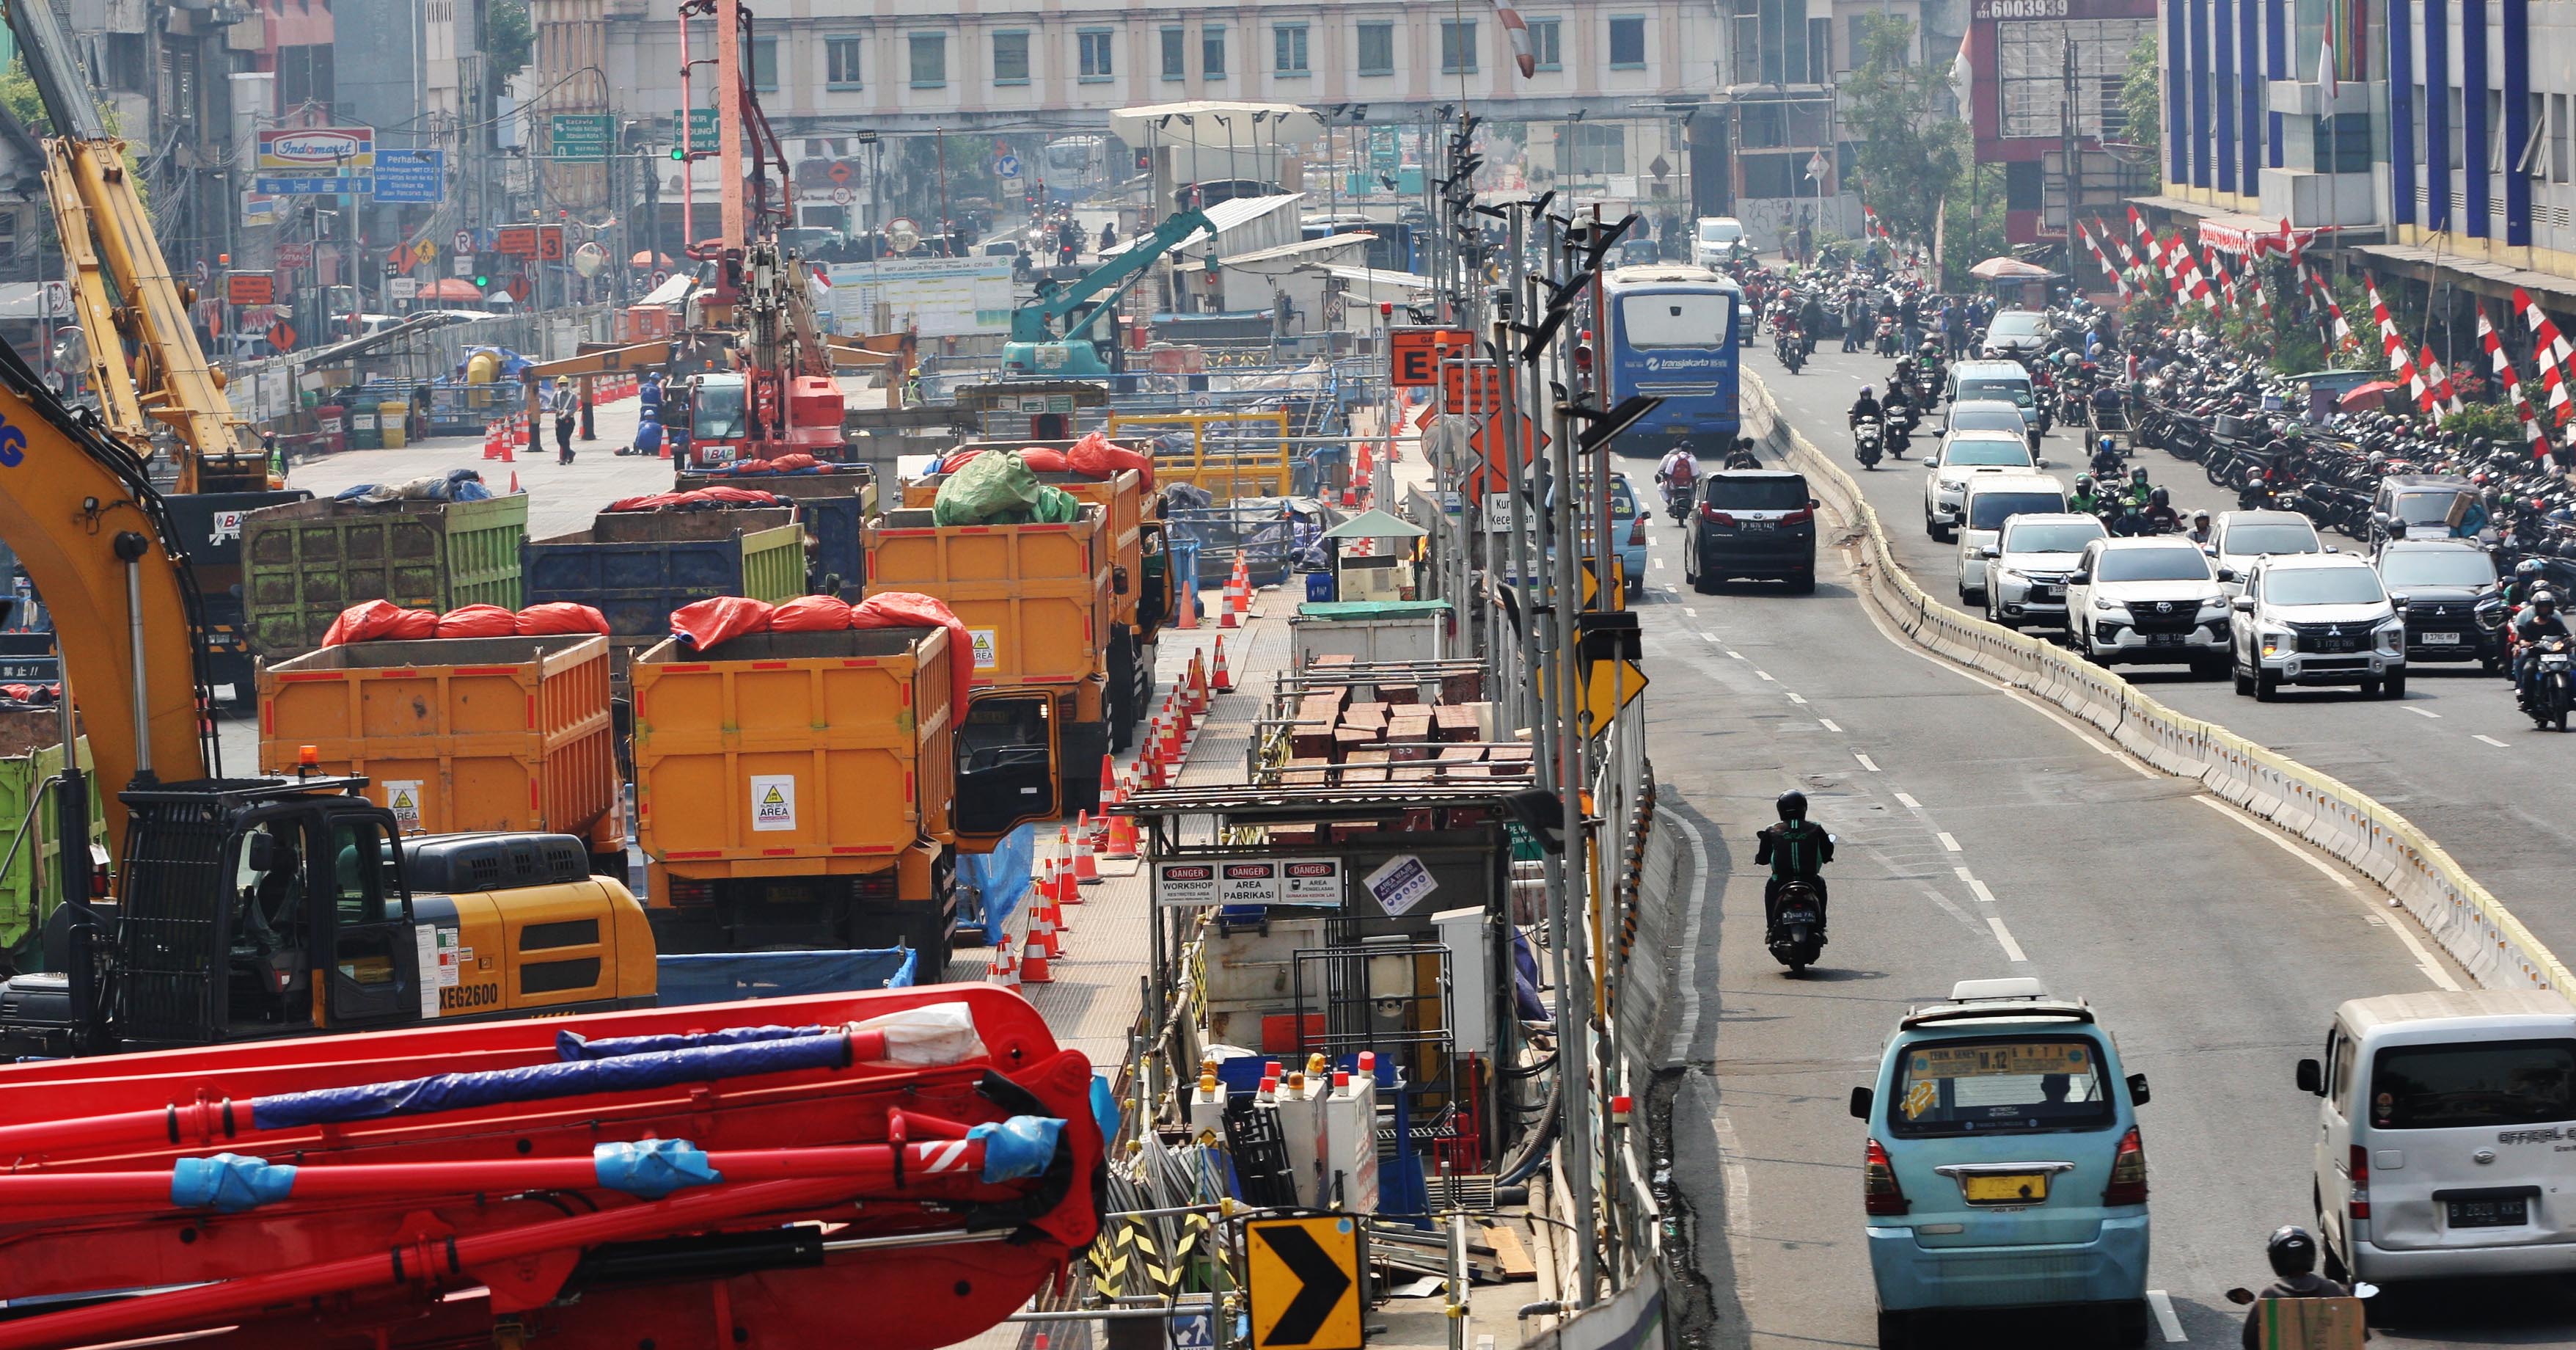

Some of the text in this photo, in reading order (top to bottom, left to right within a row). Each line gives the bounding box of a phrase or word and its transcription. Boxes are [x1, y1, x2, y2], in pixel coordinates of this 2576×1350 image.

[1976, 0, 2068, 18] 021 6003939
[676, 128, 712, 136] GDUNG
[279, 140, 352, 154] Indomaret
[1661, 359, 1709, 368] transjakarta
[710, 449, 734, 459] BAP
[1493, 514, 1534, 525] Kecean
[397, 811, 417, 820] REA
[760, 808, 788, 816] AREA
[1172, 869, 1204, 878] DANGER
[1233, 868, 1265, 876] DANGER
[1294, 866, 1326, 874] DANGER
[1163, 882, 1213, 890] WORKSHOP
[1223, 891, 1274, 900] PABRIKASI
[2451, 1203, 2459, 1217] B
